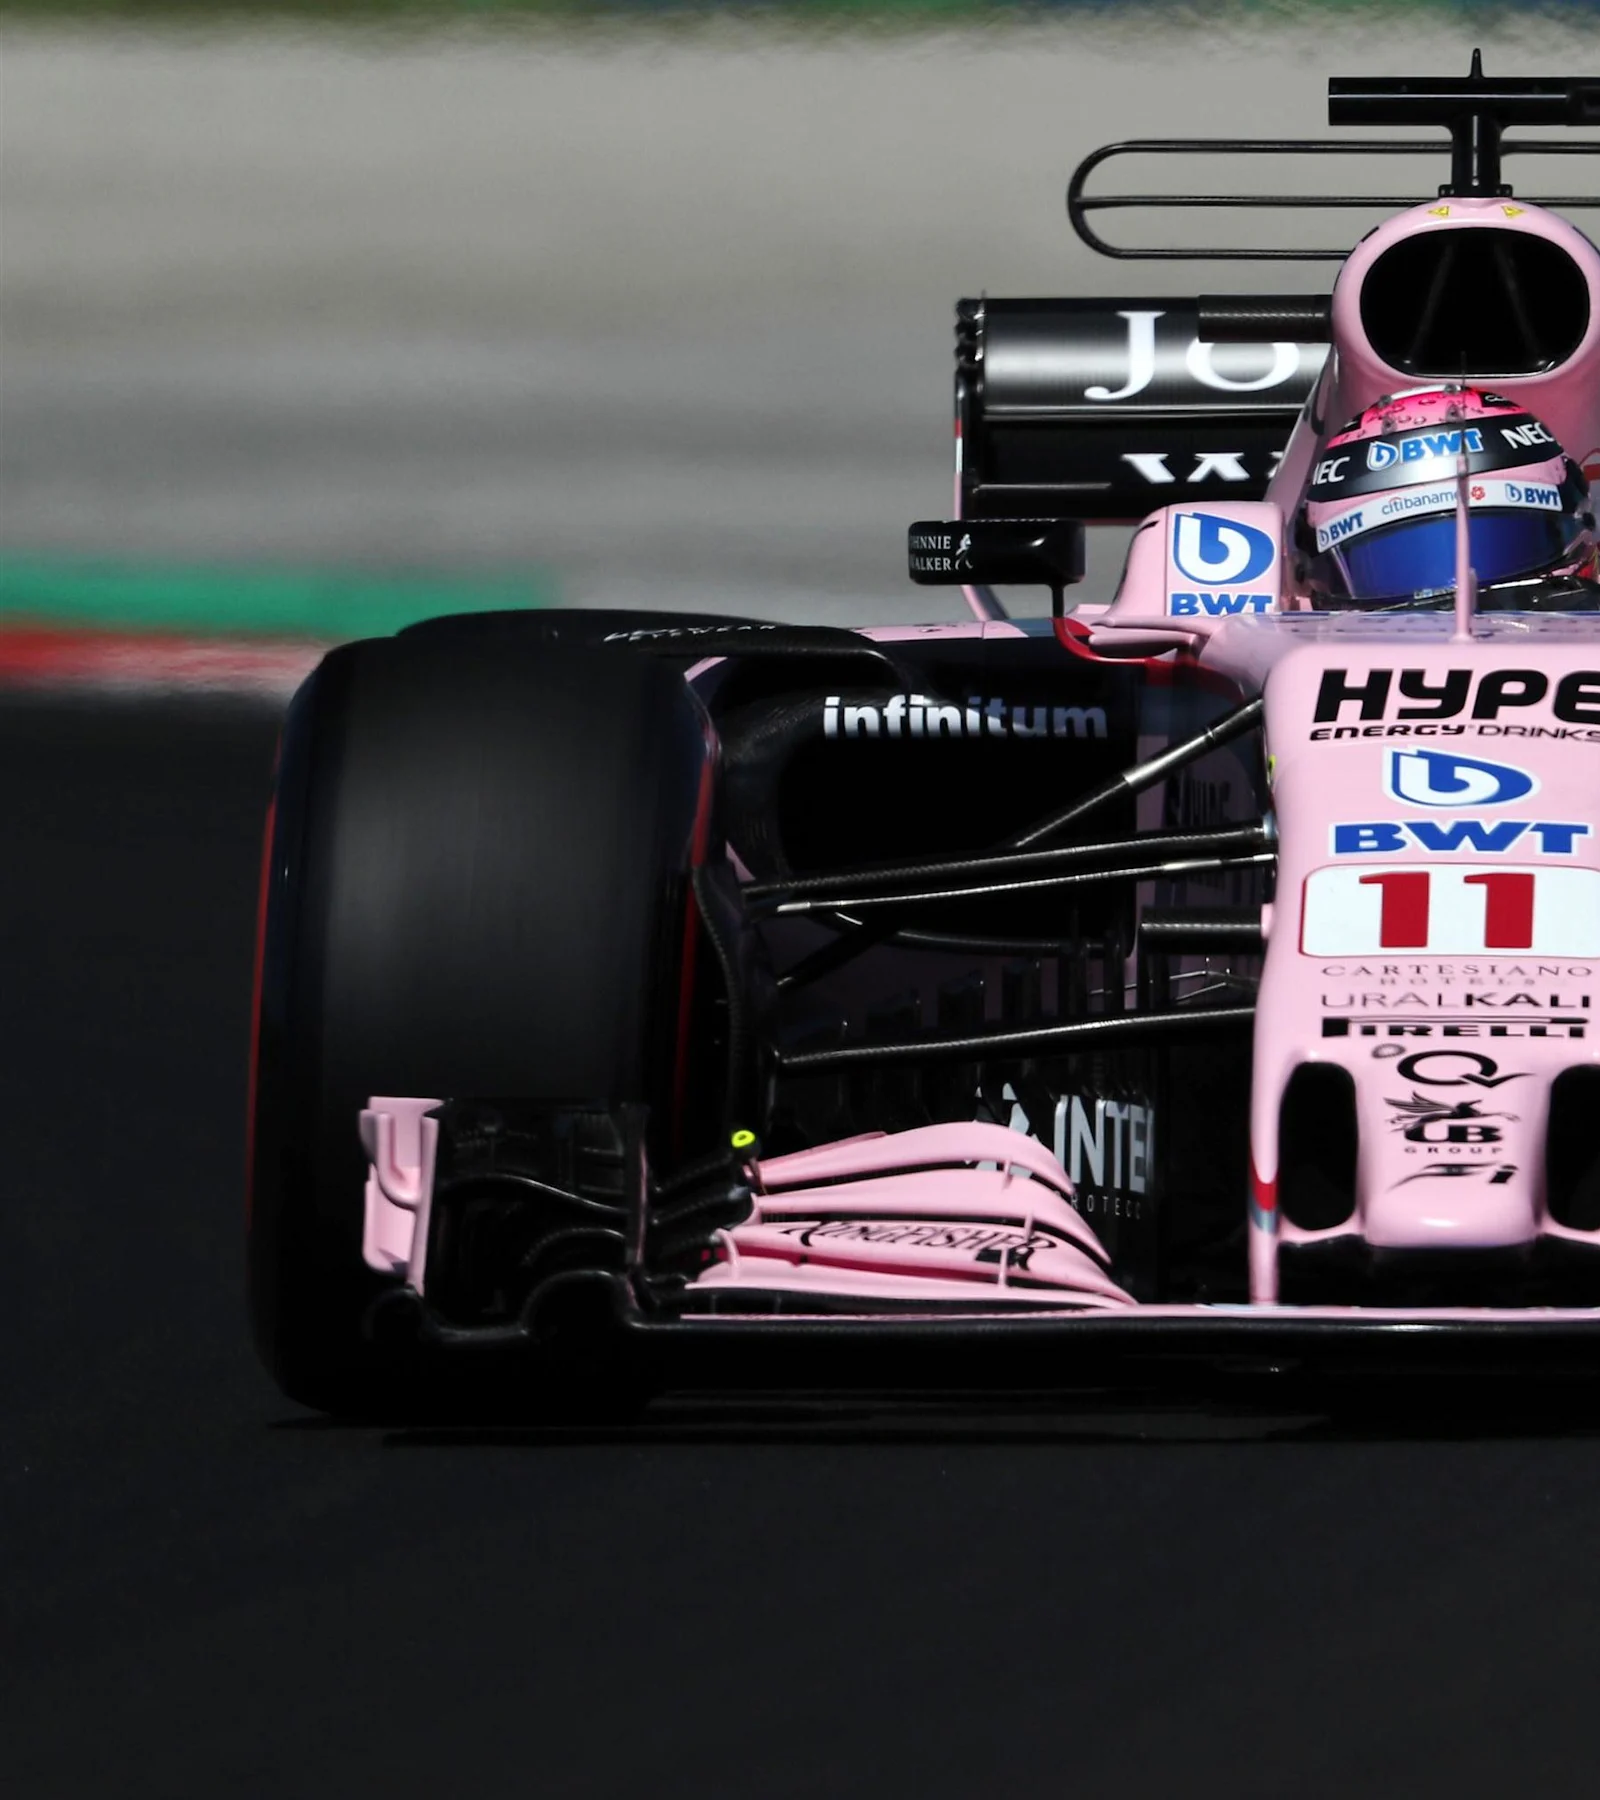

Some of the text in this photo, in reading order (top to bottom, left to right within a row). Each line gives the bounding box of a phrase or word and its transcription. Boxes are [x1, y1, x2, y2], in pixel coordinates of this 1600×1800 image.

[1401, 428, 1485, 463] BWT
[1524, 487, 1560, 506] BWT
[1329, 511, 1363, 541] BWT
[911, 555, 952, 571] ALKER
[1171, 593, 1272, 616] BWT
[823, 694, 1108, 740] infinitum
[1310, 724, 1466, 741] ENERGY
[1335, 820, 1588, 853] BWT
[1359, 871, 1534, 948] 11
[1321, 964, 1593, 977] CARTESIANO
[1321, 992, 1591, 1008] URALKALI
[1322, 1016, 1589, 1038] PIRELLI
